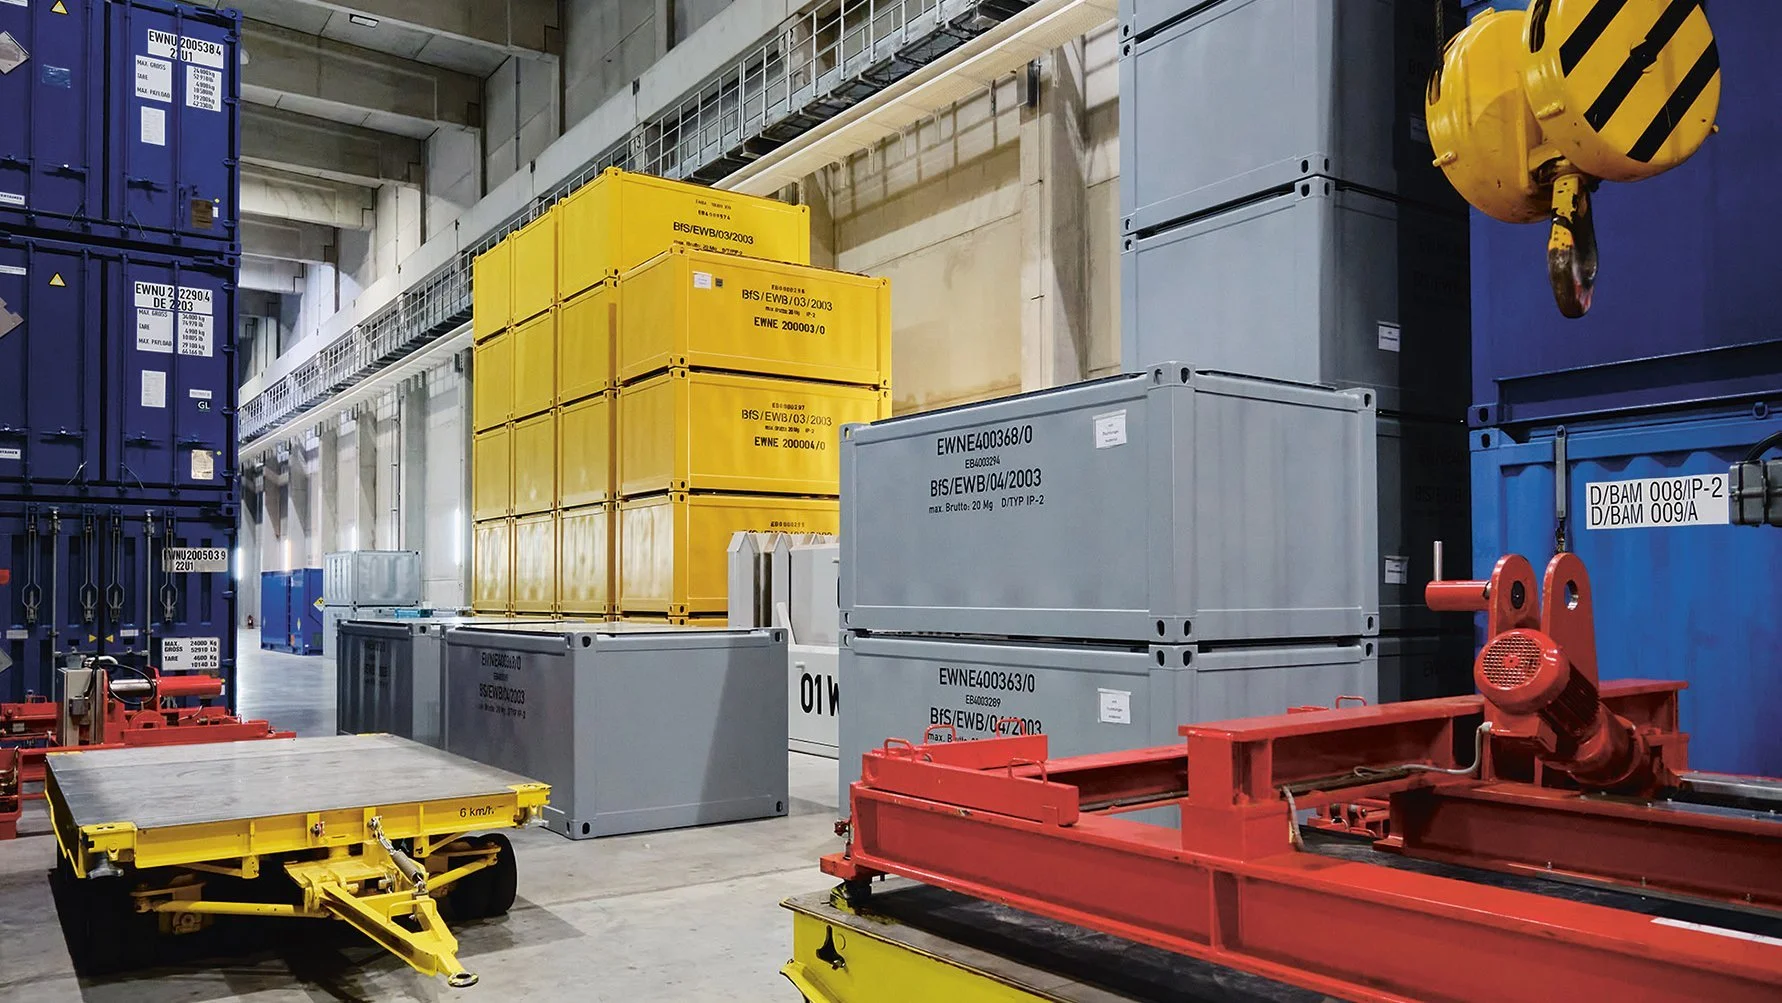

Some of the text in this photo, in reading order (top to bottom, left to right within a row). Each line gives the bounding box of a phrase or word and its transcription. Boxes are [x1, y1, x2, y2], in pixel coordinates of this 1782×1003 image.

[149, 30, 177, 46] EWNU
[170, 48, 193, 62] 2U1
[673, 222, 754, 244] BfS/EWB/03/2003
[136, 283, 165, 297] EWNU
[168, 287, 203, 301] 22290
[154, 298, 166, 309] DE
[754, 317, 825, 335] EWNE 200003/0
[198, 401, 210, 410] GL
[754, 436, 826, 450] EWNE 200004/0
[937, 425, 1032, 456] EWNE400368/0
[930, 468, 1042, 497] BfS/EWB/04/2003
[1590, 477, 1723, 505] D/BAM 008/IP-2
[928, 495, 1044, 514] max. Brutto: 20 Mg D/TYP IP-2
[1591, 501, 1698, 526] D/BAM 009/A
[176, 561, 193, 571] 22U1
[939, 668, 1035, 692] EWNE400363/0
[801, 673, 822, 715] 01
[930, 707, 1042, 736] BfS/EWB/04/2003
[928, 733, 945, 742] max.
[460, 808, 466, 818] 6
